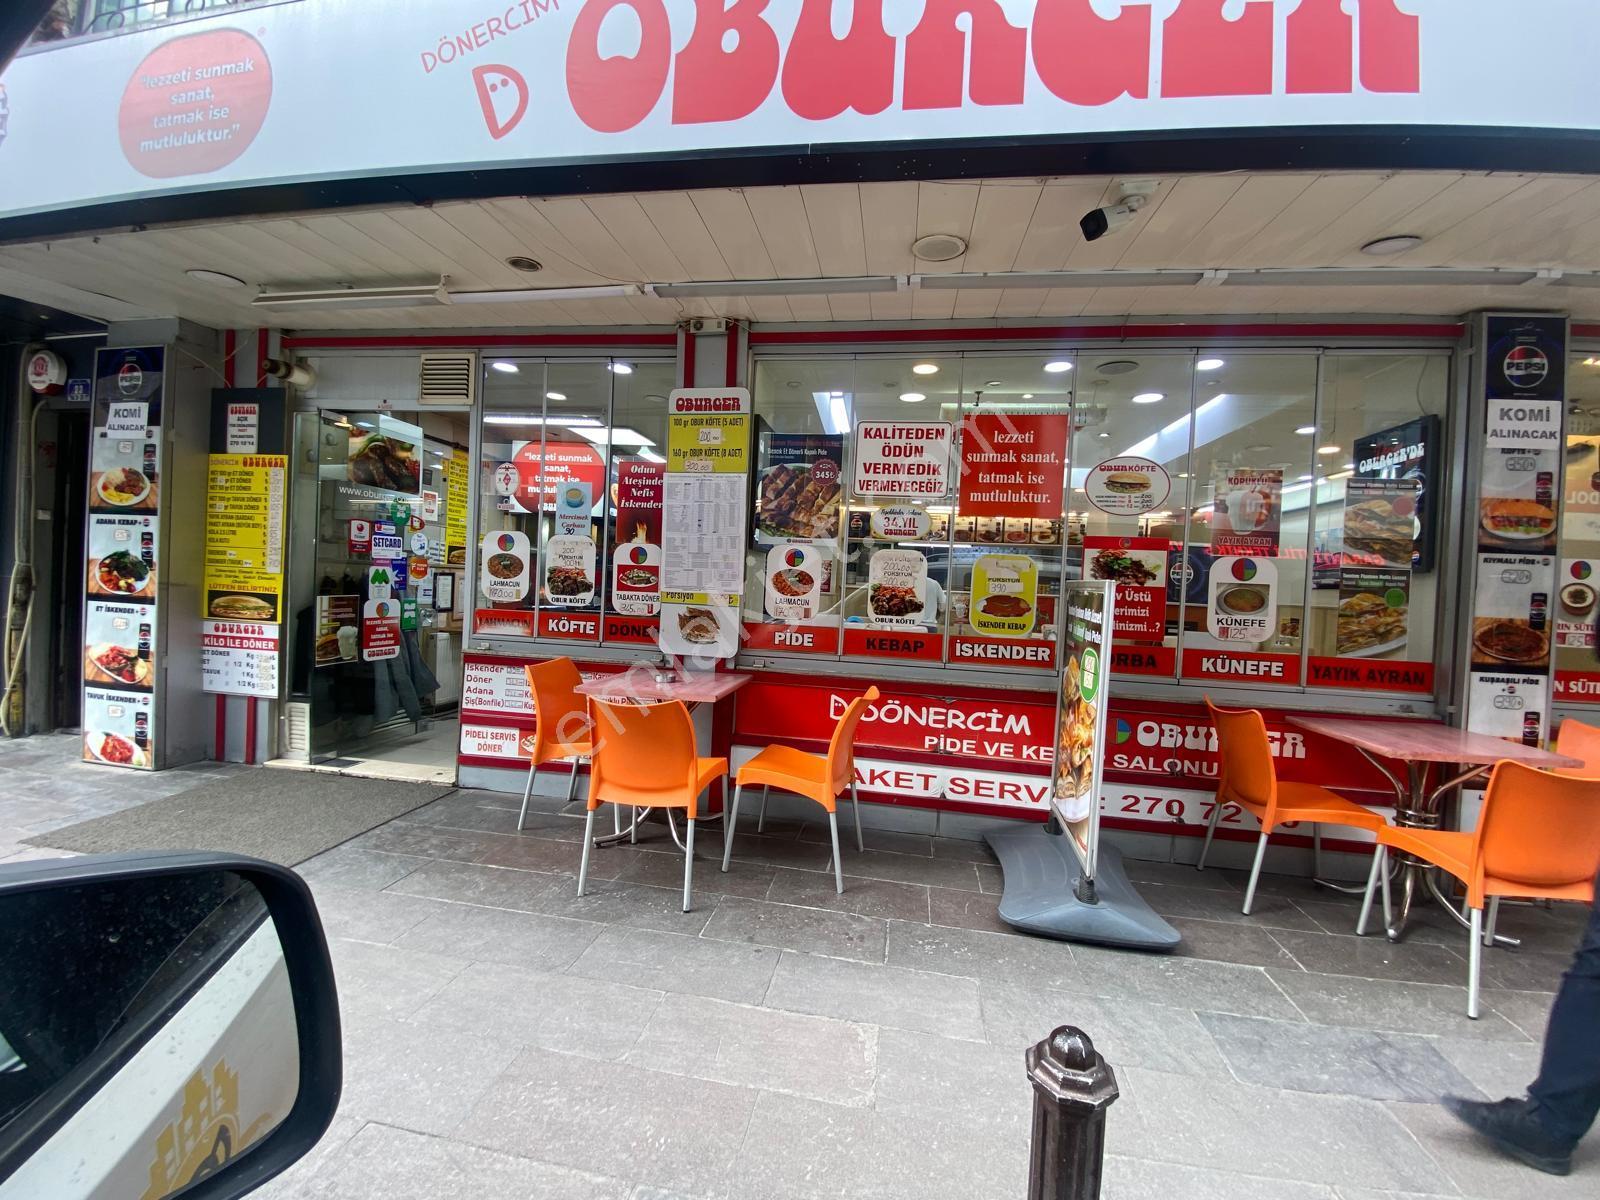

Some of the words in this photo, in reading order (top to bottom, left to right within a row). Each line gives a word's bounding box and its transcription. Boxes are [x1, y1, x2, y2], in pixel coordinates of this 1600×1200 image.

[194, 57, 255, 81] sunmak
[566, 0, 1420, 134] OBURGER
[170, 88, 215, 105] sanat,
[153, 107, 205, 129] tatmak
[208, 104, 229, 121] ise
[1507, 361, 1545, 372] PEPSI
[676, 397, 741, 412] OBURGER
[114, 406, 141, 418] KOMİ
[1499, 406, 1551, 423] KOMİ
[108, 424, 145, 432] ALINACAK
[673, 418, 682, 426] 100
[690, 418, 704, 426] OBUR
[705, 417, 721, 426] KÖFTE
[864, 425, 945, 440] KALİTEDEN
[994, 431, 1033, 444] lezzeti
[1489, 429, 1558, 440] ALINACAK
[524, 452, 556, 461] “lezeti
[558, 453, 593, 462] sunmak
[690, 449, 703, 457] OBUR
[704, 447, 720, 457] KÖFTE
[882, 443, 924, 458] ÖDÜN
[966, 450, 1017, 463] sunmak
[1021, 450, 1059, 465] sanat,
[544, 465, 572, 473] sanat,
[630, 465, 656, 474] Odun
[863, 461, 942, 476] VERMEDİK
[622, 476, 664, 486] Ateşinde
[978, 472, 1024, 484] tatmak
[1027, 472, 1045, 484] ise
[859, 478, 944, 493] VERMEYECEĞİZ
[630, 488, 654, 497] Nefis
[969, 489, 1051, 503] mutluluktur.
[620, 499, 664, 509] İskender
[373, 537, 402, 548] SETCARD
[490, 580, 521, 588] LAHMACUN
[616, 593, 640, 601] TABAKTA
[641, 593, 660, 602] DÖNER
[1125, 588, 1152, 602] Üstü
[775, 598, 810, 606] LAHMACUN
[1113, 606, 1150, 618] erimizi
[548, 617, 596, 635] KÖFTE
[978, 619, 1006, 629] İSKENDER
[1007, 622, 1027, 631] KEBAP
[1216, 616, 1266, 628] KÜNEFE
[204, 636, 225, 646] KİLO
[226, 636, 241, 647] İLE
[242, 639, 275, 649] DÖNER
[774, 629, 814, 646] PİDE
[866, 638, 925, 653] KEBAP
[955, 640, 1050, 661] İSKENDER
[1201, 655, 1284, 677] KÜNEFE
[466, 674, 493, 684] Döner
[1312, 664, 1361, 682] YAYIK
[1366, 667, 1425, 686] AYRAN
[1522, 675, 1540, 685] PİDE
[466, 686, 494, 695] Adana
[465, 729, 489, 740] PİDELİ
[490, 729, 517, 742] SERVİS
[1136, 720, 1306, 759] OBUER
[924, 734, 976, 754] PİDE
[984, 741, 1015, 758] VE
[1113, 754, 1219, 776] SALONU
[850, 768, 937, 791] AKET
[950, 777, 1049, 803] SERV
[1119, 795, 1185, 817] 270
[1200, 801, 1243, 824] 72
